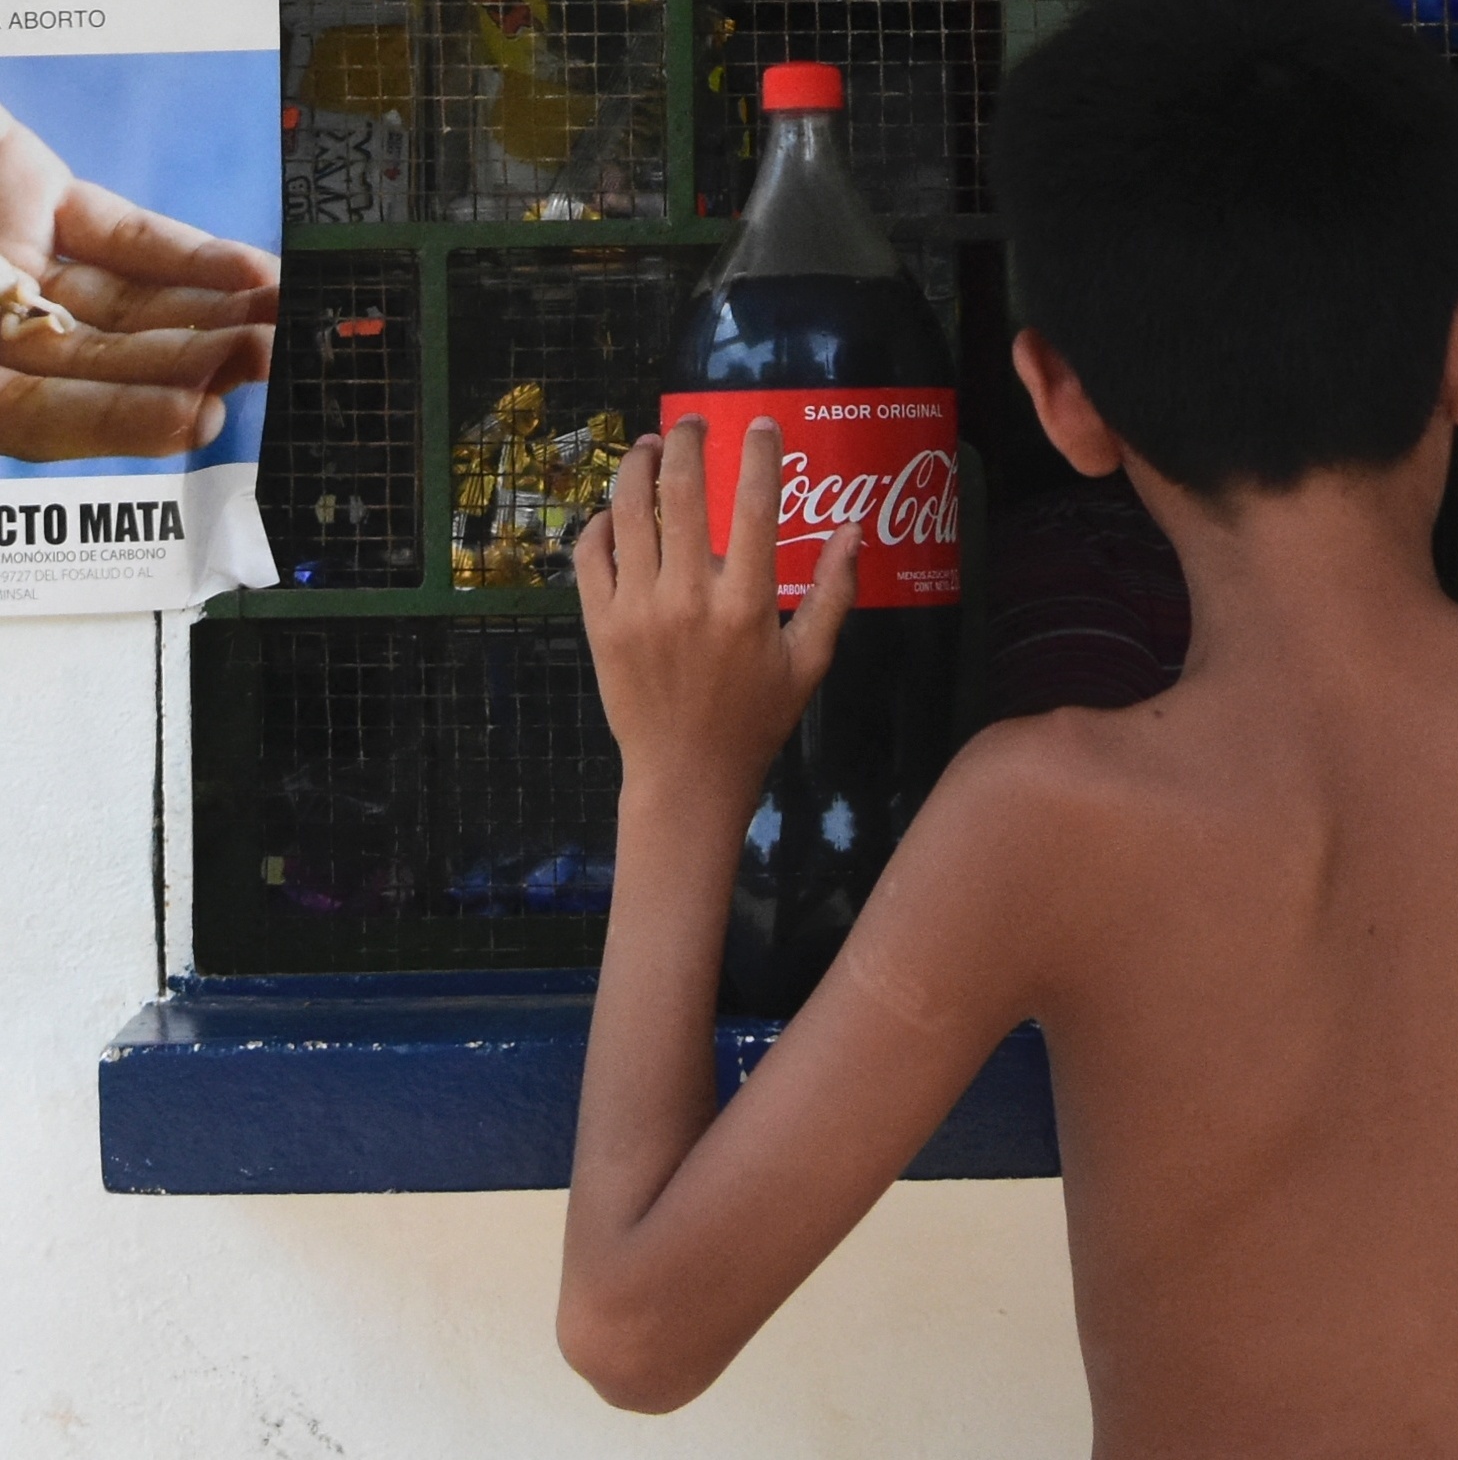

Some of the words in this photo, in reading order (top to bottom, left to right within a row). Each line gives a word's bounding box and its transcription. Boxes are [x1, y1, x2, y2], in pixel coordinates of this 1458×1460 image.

[8, 9, 106, 30] ABORTO
[804, 404, 871, 420] SABOR
[877, 403, 943, 418] ORIGINAL
[79, 500, 185, 543] MATA
[1, 549, 76, 564] MONÓXIDO
[80, 550, 97, 562] DE
[100, 548, 166, 561] CARBONO
[35, 569, 58, 581] DEL
[124, 566, 134, 578] O
